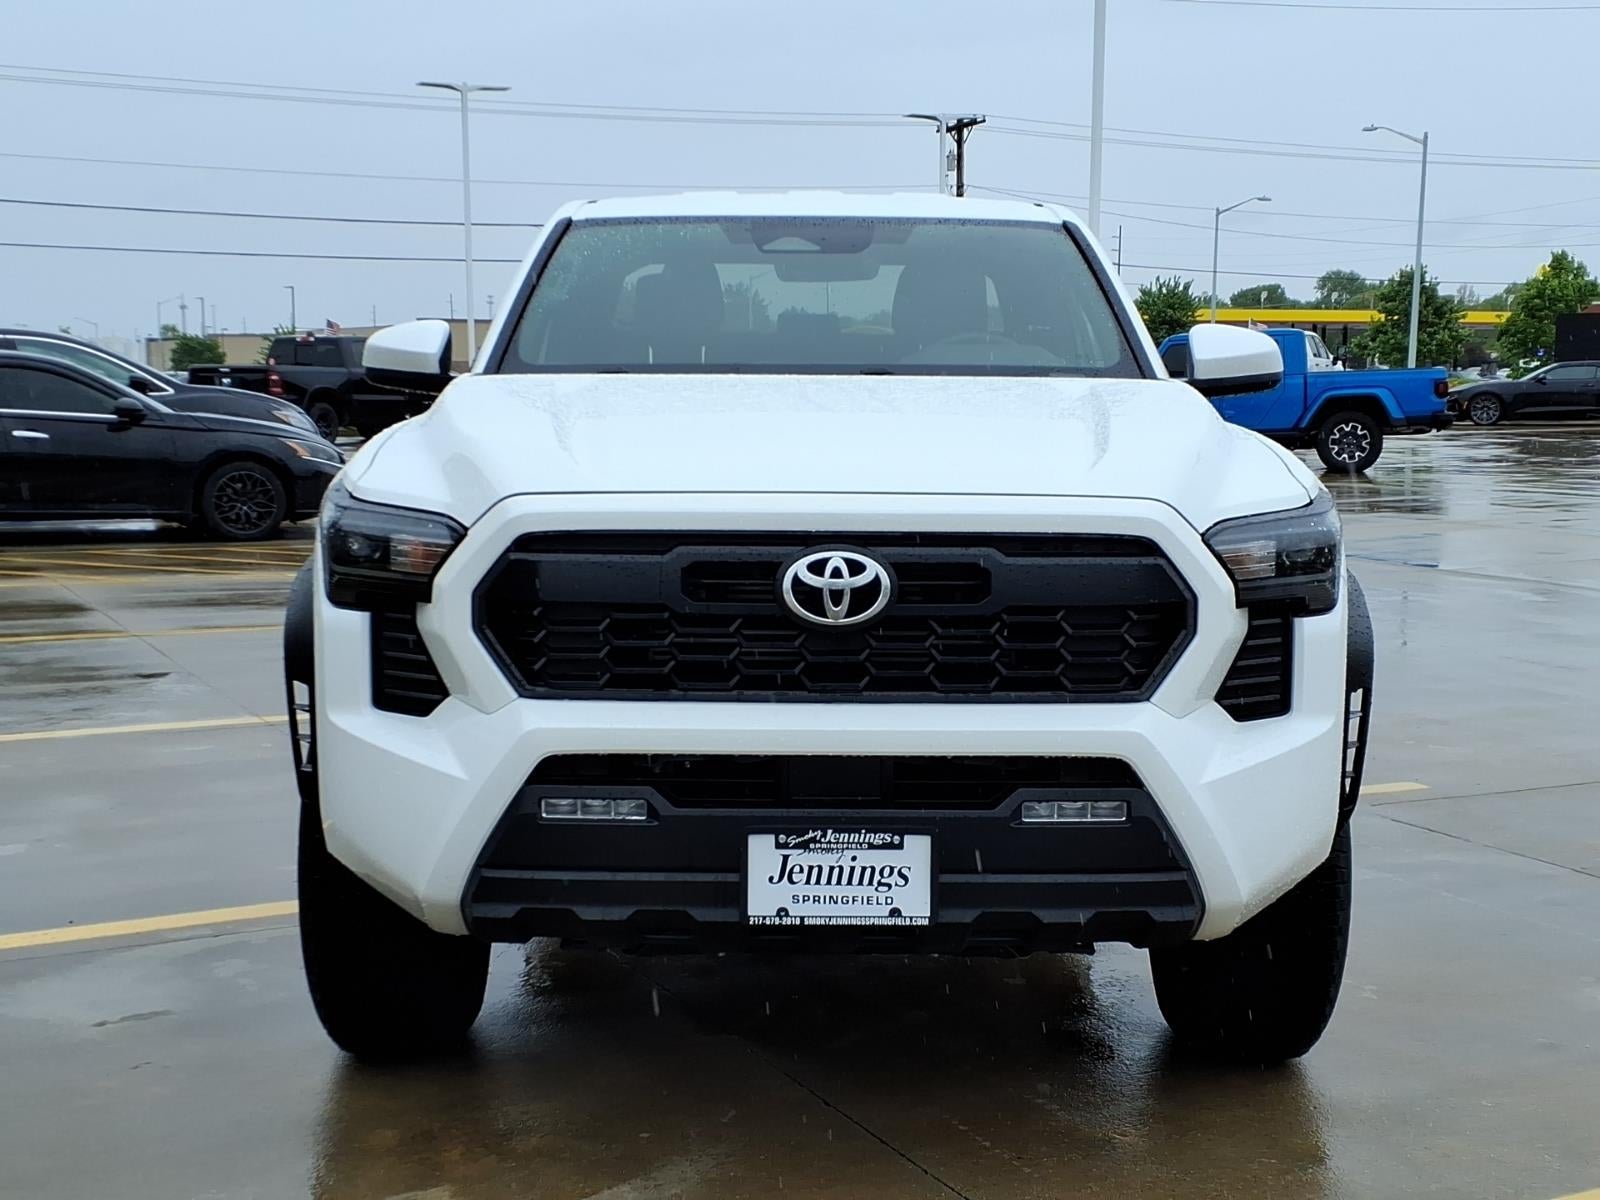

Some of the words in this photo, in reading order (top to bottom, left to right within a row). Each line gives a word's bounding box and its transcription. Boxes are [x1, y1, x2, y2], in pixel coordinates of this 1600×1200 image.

[787, 829, 822, 847] Smoky
[821, 829, 892, 845] Jennings
[768, 853, 912, 893] Jennings
[791, 894, 895, 906] SPRINGFIELD
[804, 916, 930, 926] SMOKYJENNINGSSPRINGFIELD.COM
